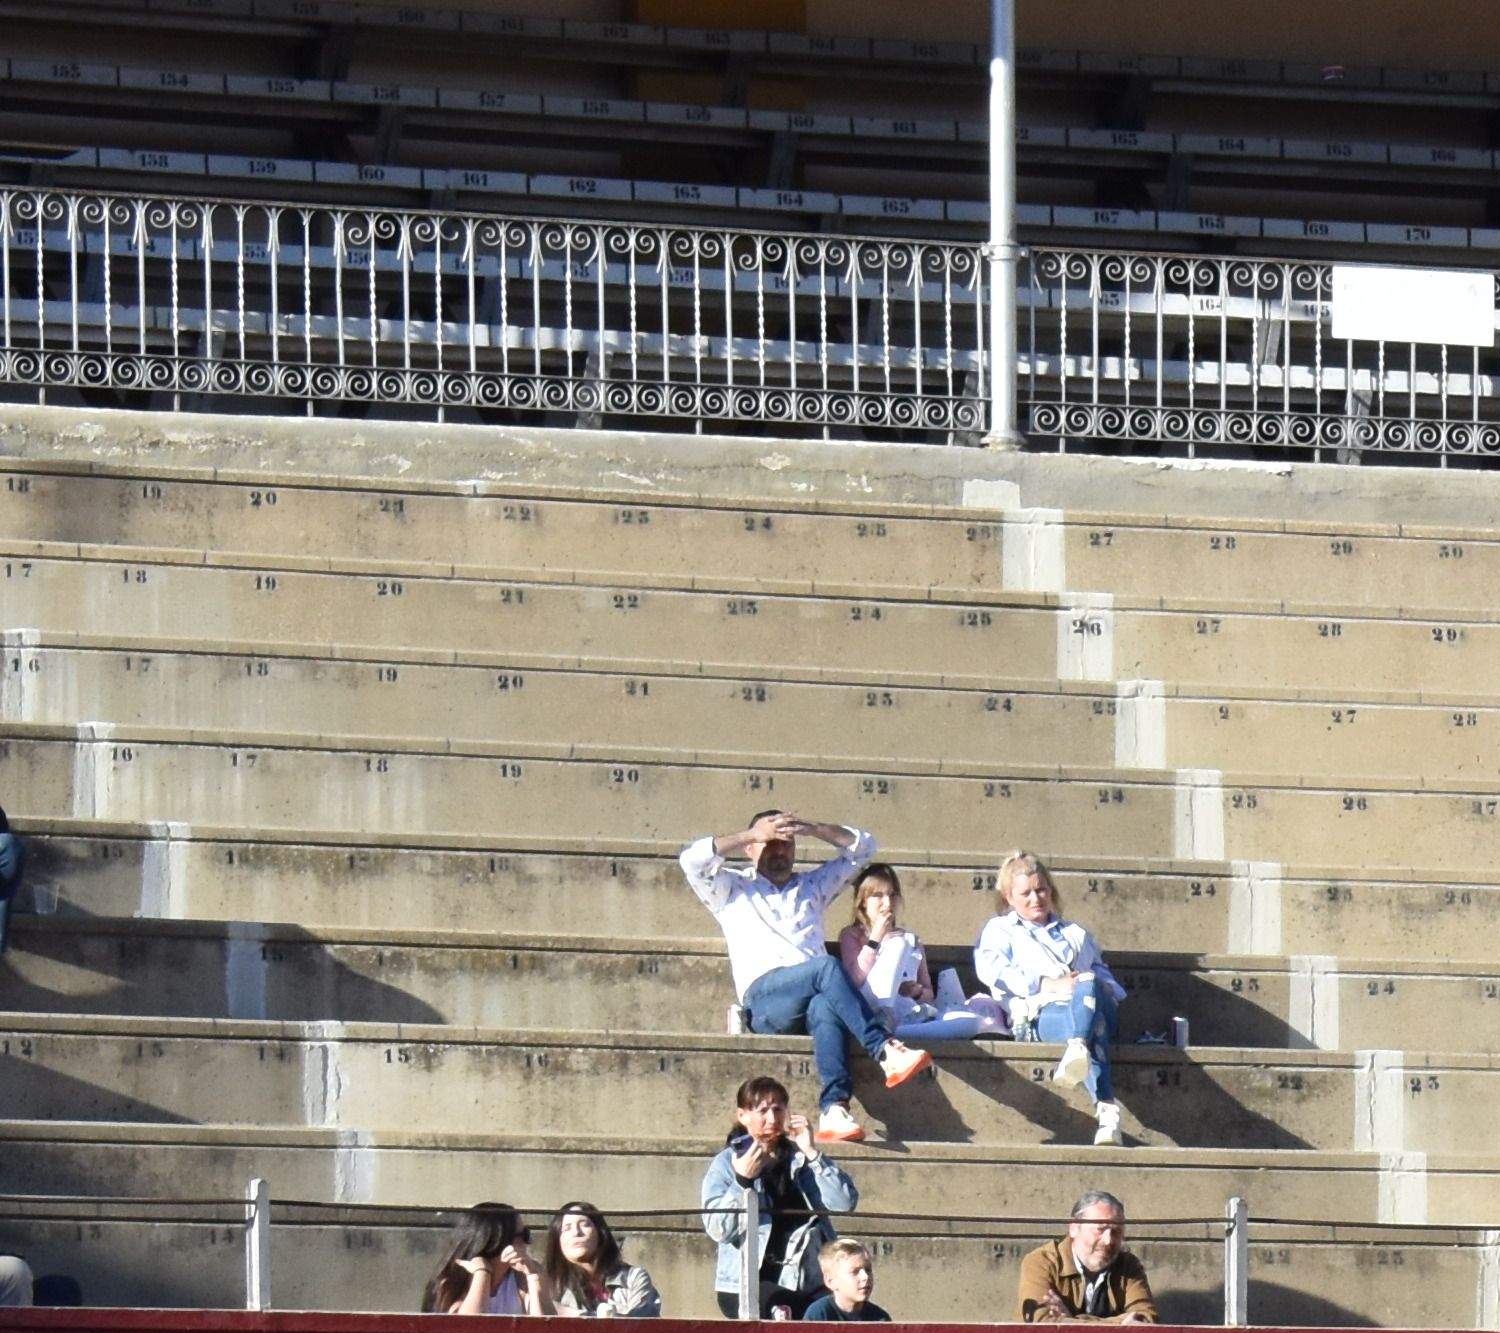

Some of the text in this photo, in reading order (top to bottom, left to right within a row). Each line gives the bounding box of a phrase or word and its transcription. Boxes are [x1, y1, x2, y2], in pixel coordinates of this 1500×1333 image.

[7, 477, 30, 493] 18
[142, 484, 162, 500] 19
[250, 491, 277, 508] 20
[744, 516, 773, 532] 24
[1089, 530, 1114, 547] 27
[1210, 536, 1236, 550] 28
[1330, 540, 1353, 556] 29
[5, 562, 33, 578] 17
[123, 568, 147, 584] 18
[255, 575, 277, 591] 19
[376, 581, 403, 596] 20
[613, 594, 639, 609] 22
[1072, 617, 1102, 637] 26
[1196, 618, 1221, 635] 27
[1317, 623, 1342, 638] 28
[1431, 628, 1458, 642] 29
[378, 667, 398, 682] 19
[497, 674, 524, 690] 20
[1331, 709, 1357, 724] 27
[1452, 713, 1477, 727] 28
[112, 746, 133, 762] 16
[230, 752, 258, 767] 17
[363, 757, 389, 773] 18
[500, 763, 522, 778] 19
[613, 769, 639, 783] 20
[862, 779, 889, 795] 22
[1098, 788, 1125, 804] 24
[1342, 796, 1367, 811] 26
[1190, 882, 1217, 897] 24
[1367, 980, 1396, 996] 24
